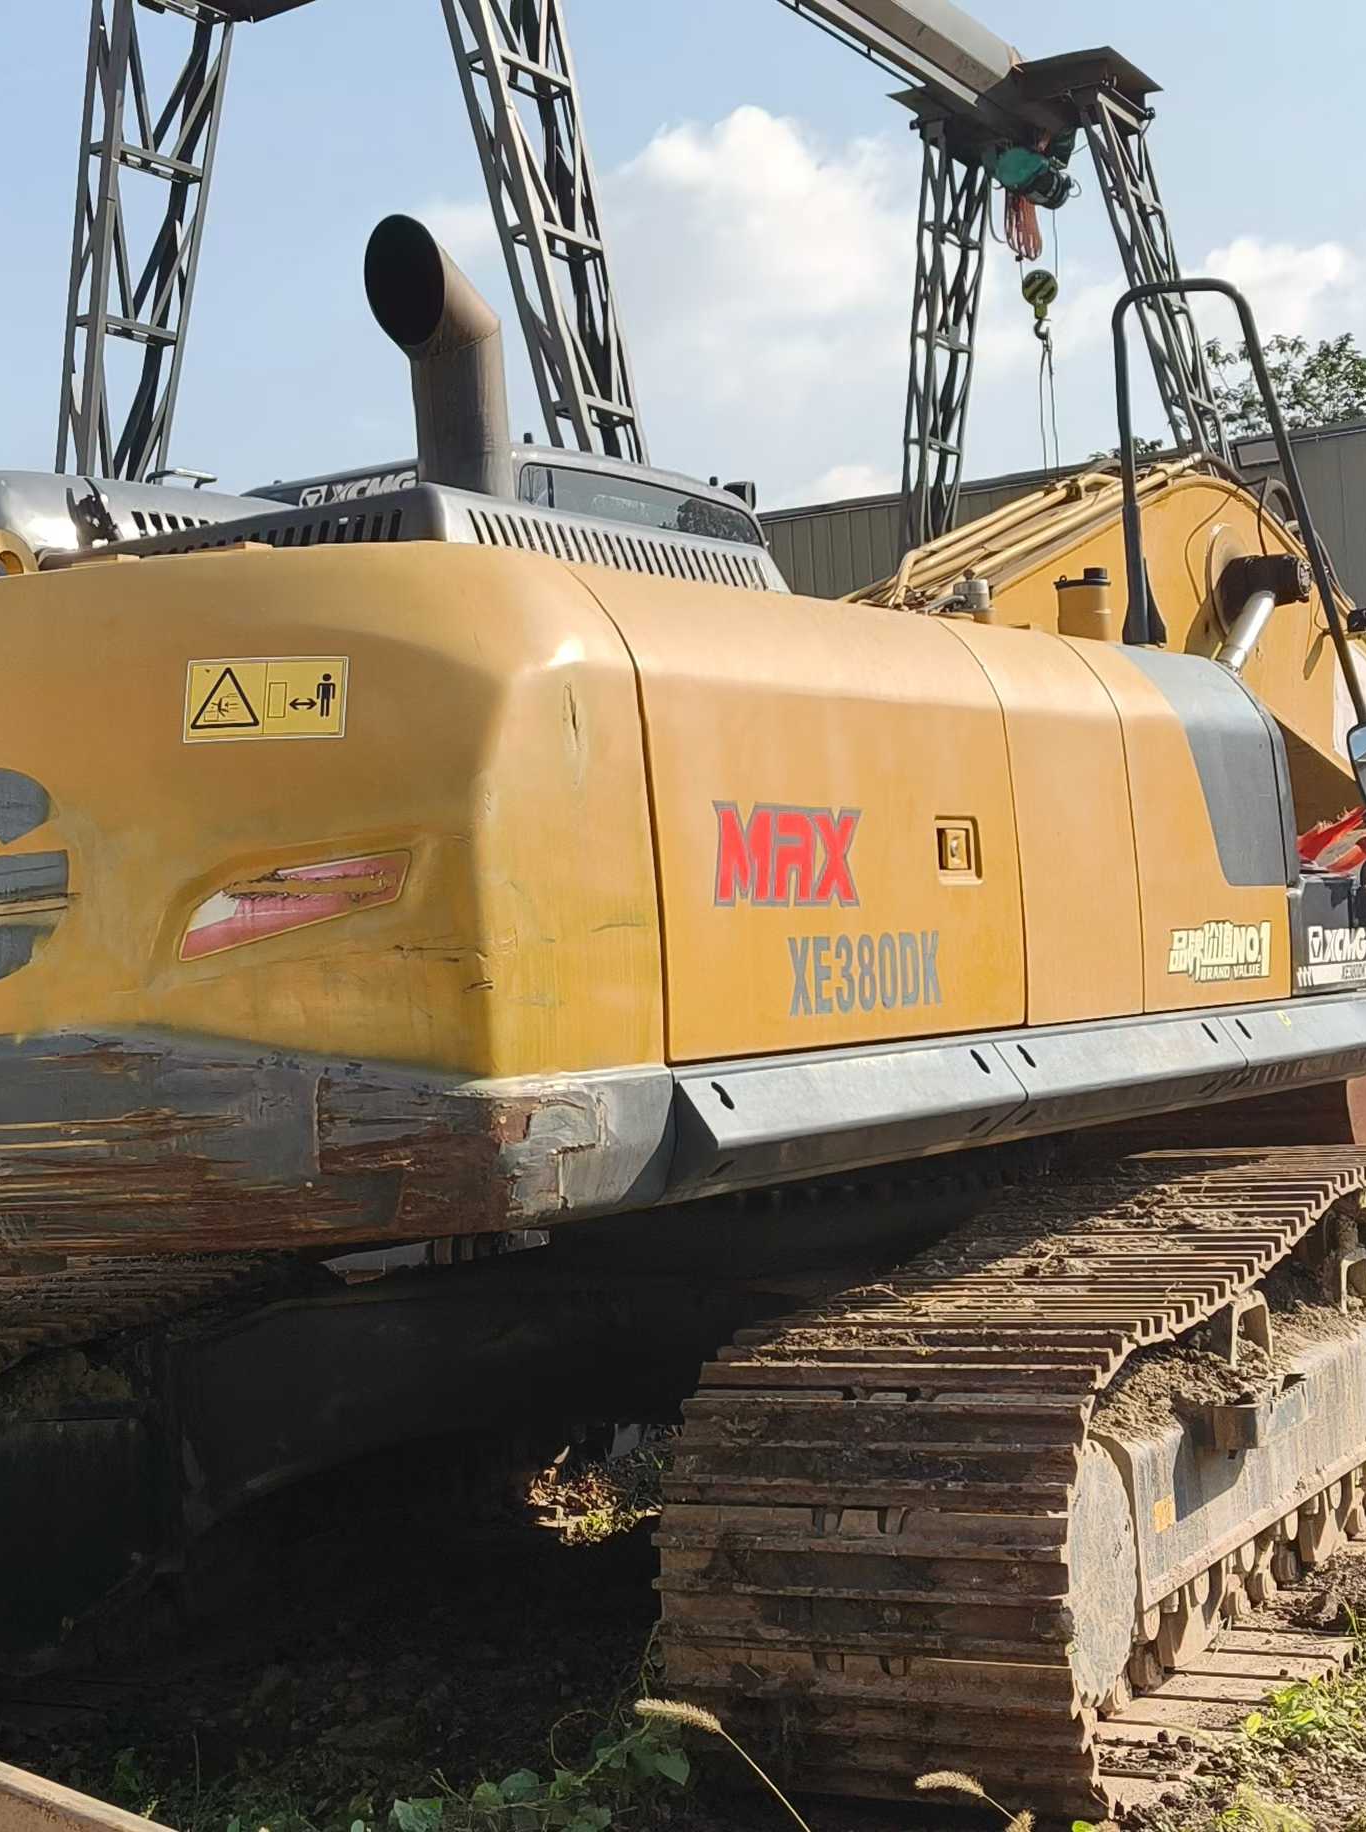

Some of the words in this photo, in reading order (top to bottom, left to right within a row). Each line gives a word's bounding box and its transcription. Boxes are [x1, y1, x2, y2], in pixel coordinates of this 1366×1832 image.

[330, 470, 417, 503] XCMG
[712, 800, 862, 907] MAX
[1322, 927, 1366, 962] XCMG
[787, 930, 942, 1016] XE380DK
[1200, 966, 1230, 981] BRAND
[1234, 963, 1261, 978] VALUE
